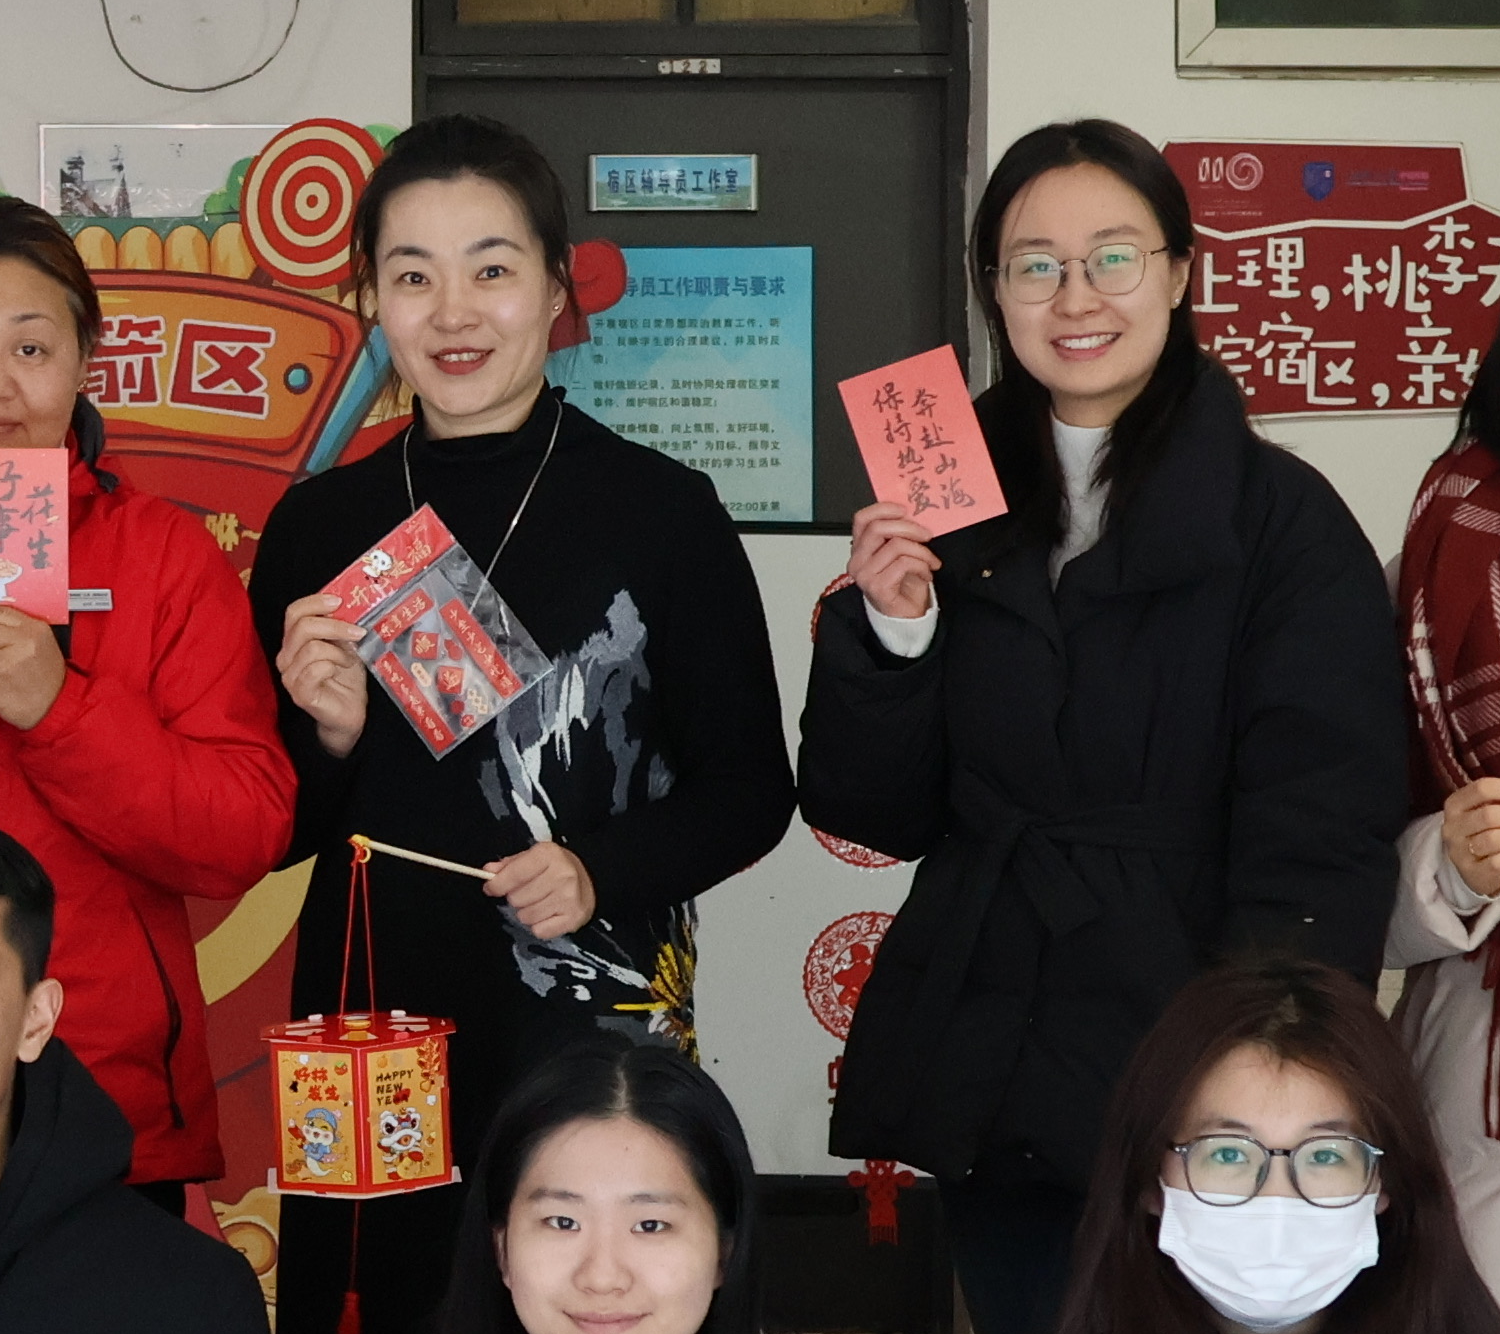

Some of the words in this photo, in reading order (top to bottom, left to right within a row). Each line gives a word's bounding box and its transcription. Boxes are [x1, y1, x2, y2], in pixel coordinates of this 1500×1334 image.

[607, 168, 740, 195] 宿区辅导员工作室
[376, 1069, 414, 1083] HAPPY
[376, 1083, 403, 1095] NEW
